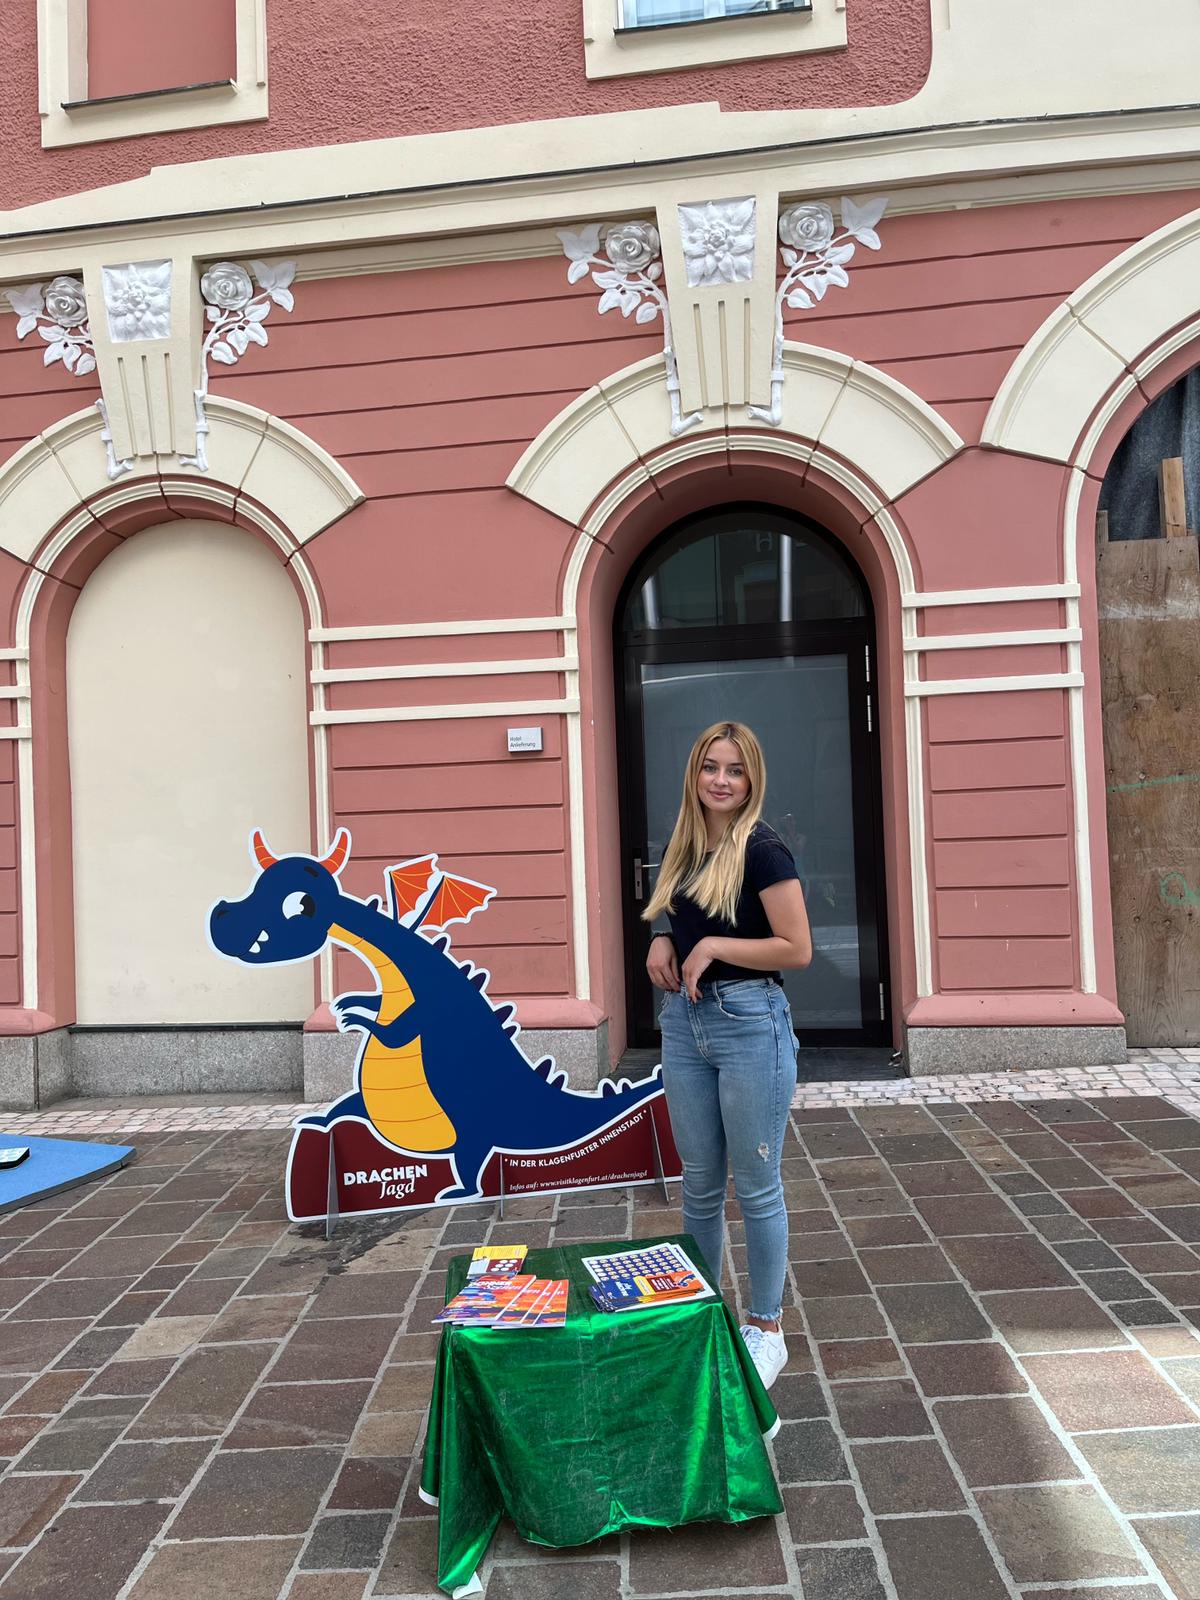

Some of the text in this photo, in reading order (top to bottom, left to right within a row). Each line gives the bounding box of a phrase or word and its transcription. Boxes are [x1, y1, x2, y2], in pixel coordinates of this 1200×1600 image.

[509, 1112, 644, 1168] IN DER KLAGENFURTER INNENSTADT
[343, 1164, 428, 1186] DRACHEN
[379, 1174, 415, 1199] Jagd
[509, 1170, 648, 1192] Infos auf: www.visitklagenfurt.at/drachenjagd
